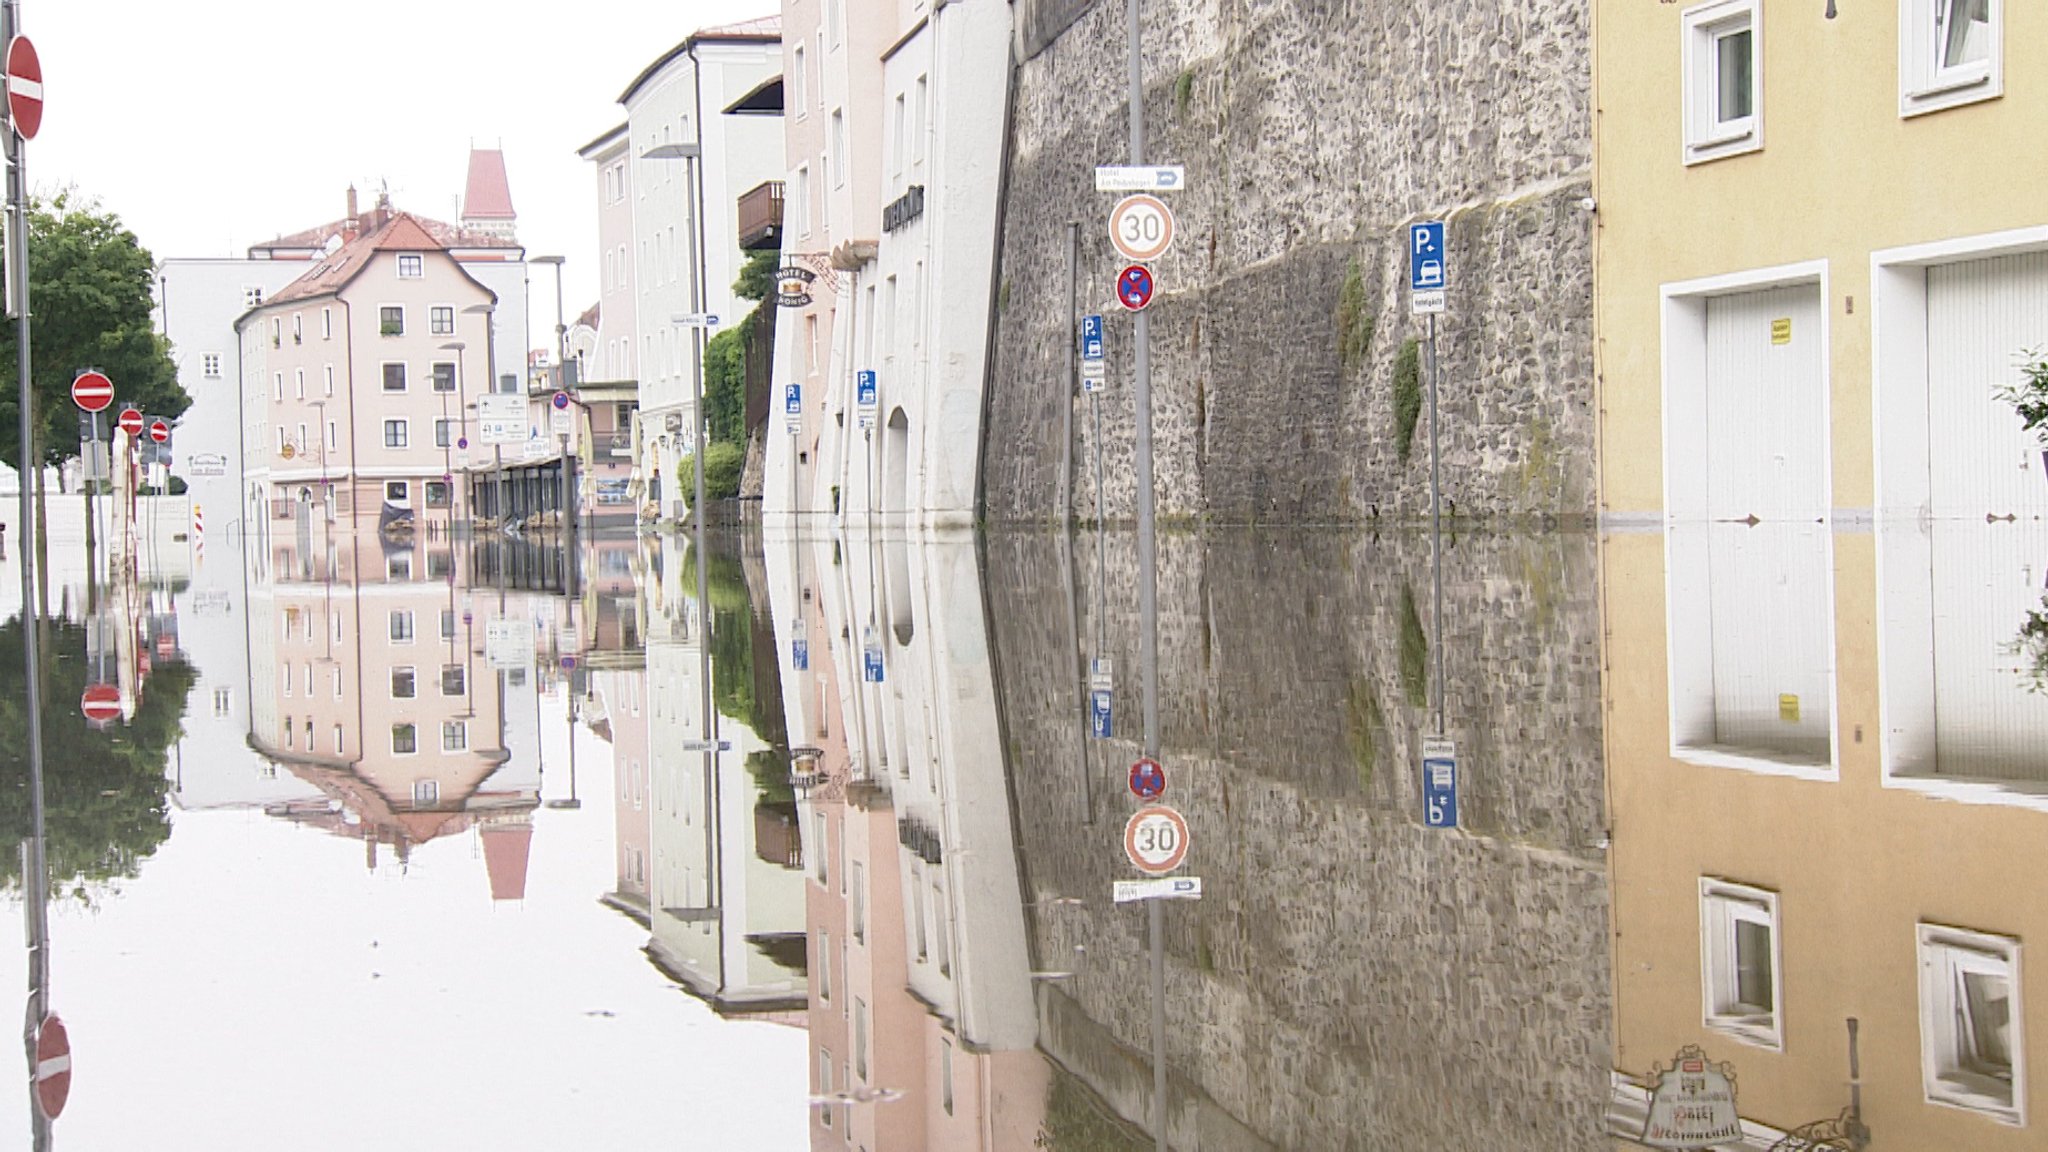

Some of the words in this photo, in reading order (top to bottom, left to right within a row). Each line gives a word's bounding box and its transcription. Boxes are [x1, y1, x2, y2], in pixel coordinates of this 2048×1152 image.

[1124, 213, 1159, 242] 30
[1416, 228, 1430, 254] P
[775, 268, 806, 279] HOTEL
[1085, 319, 1095, 336] P
